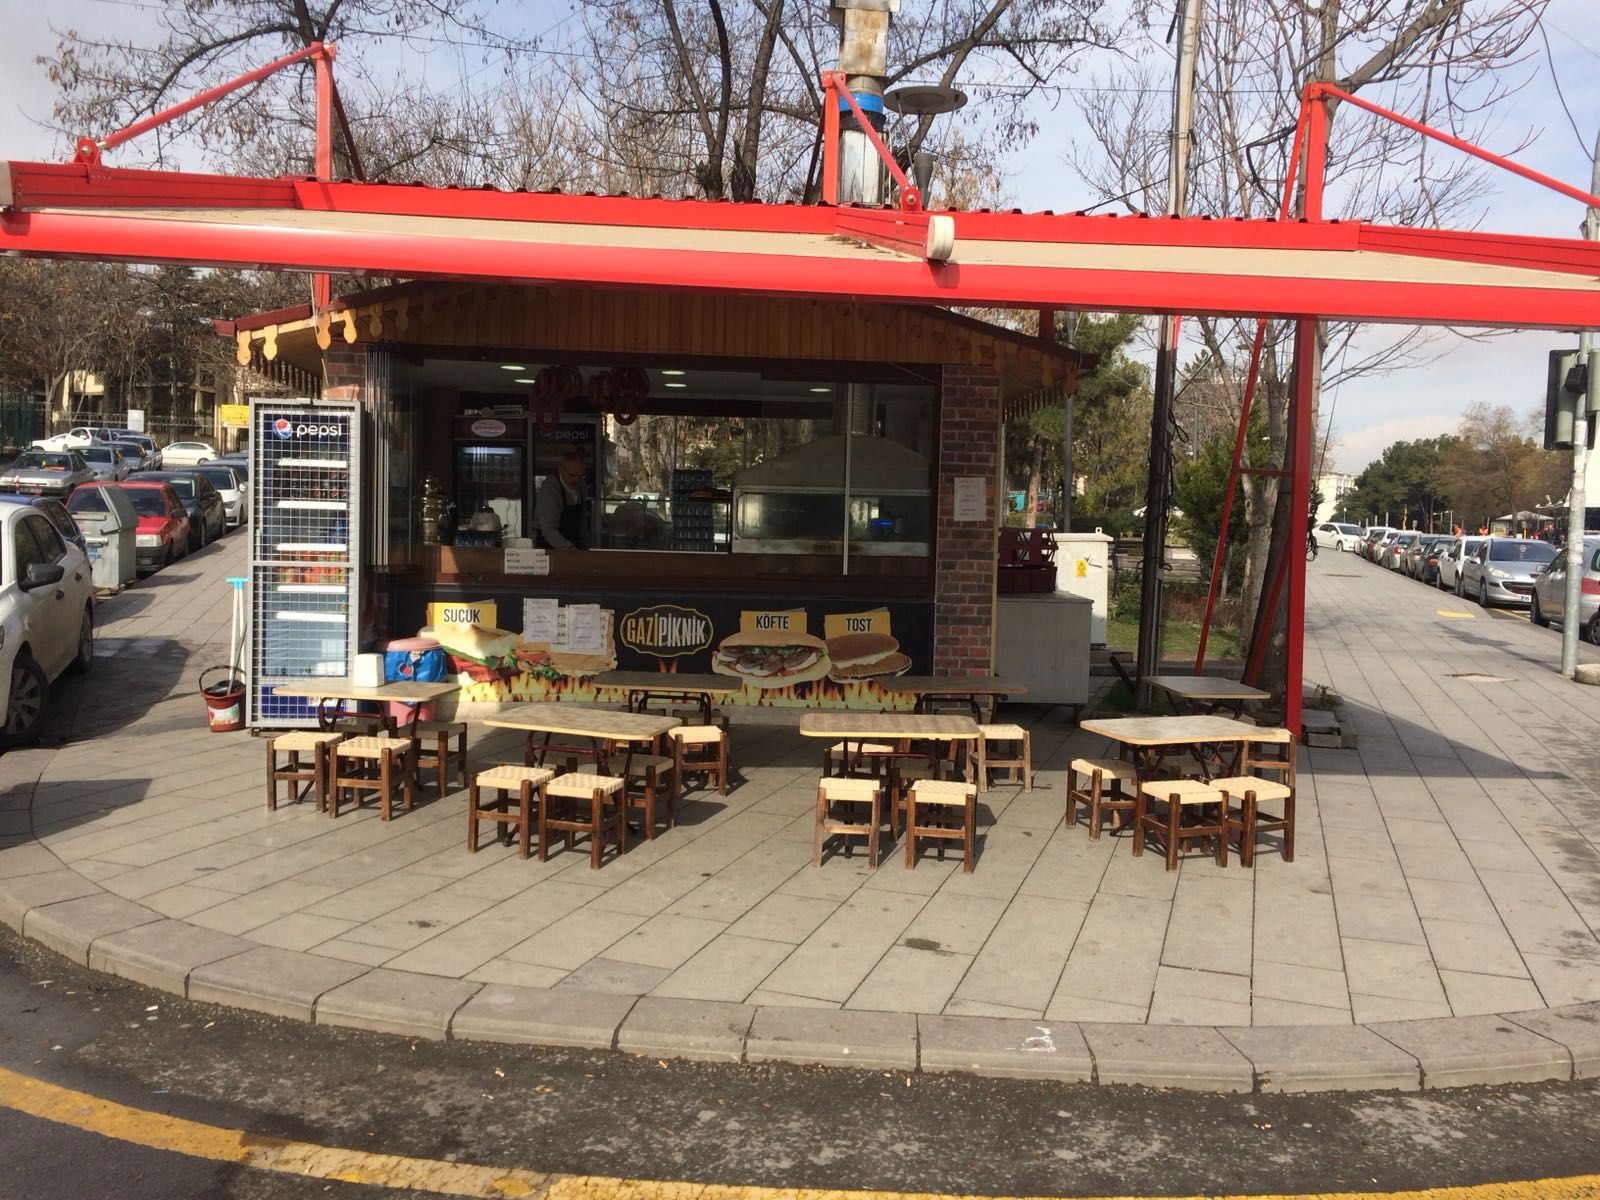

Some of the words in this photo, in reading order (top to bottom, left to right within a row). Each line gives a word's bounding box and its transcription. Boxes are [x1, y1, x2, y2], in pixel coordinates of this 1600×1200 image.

[296, 423, 342, 439] pepsi
[555, 430, 589, 442] pepsi
[443, 608, 481, 623] SUCUK
[755, 613, 789, 629] KÖFTE
[846, 617, 872, 632] TOST
